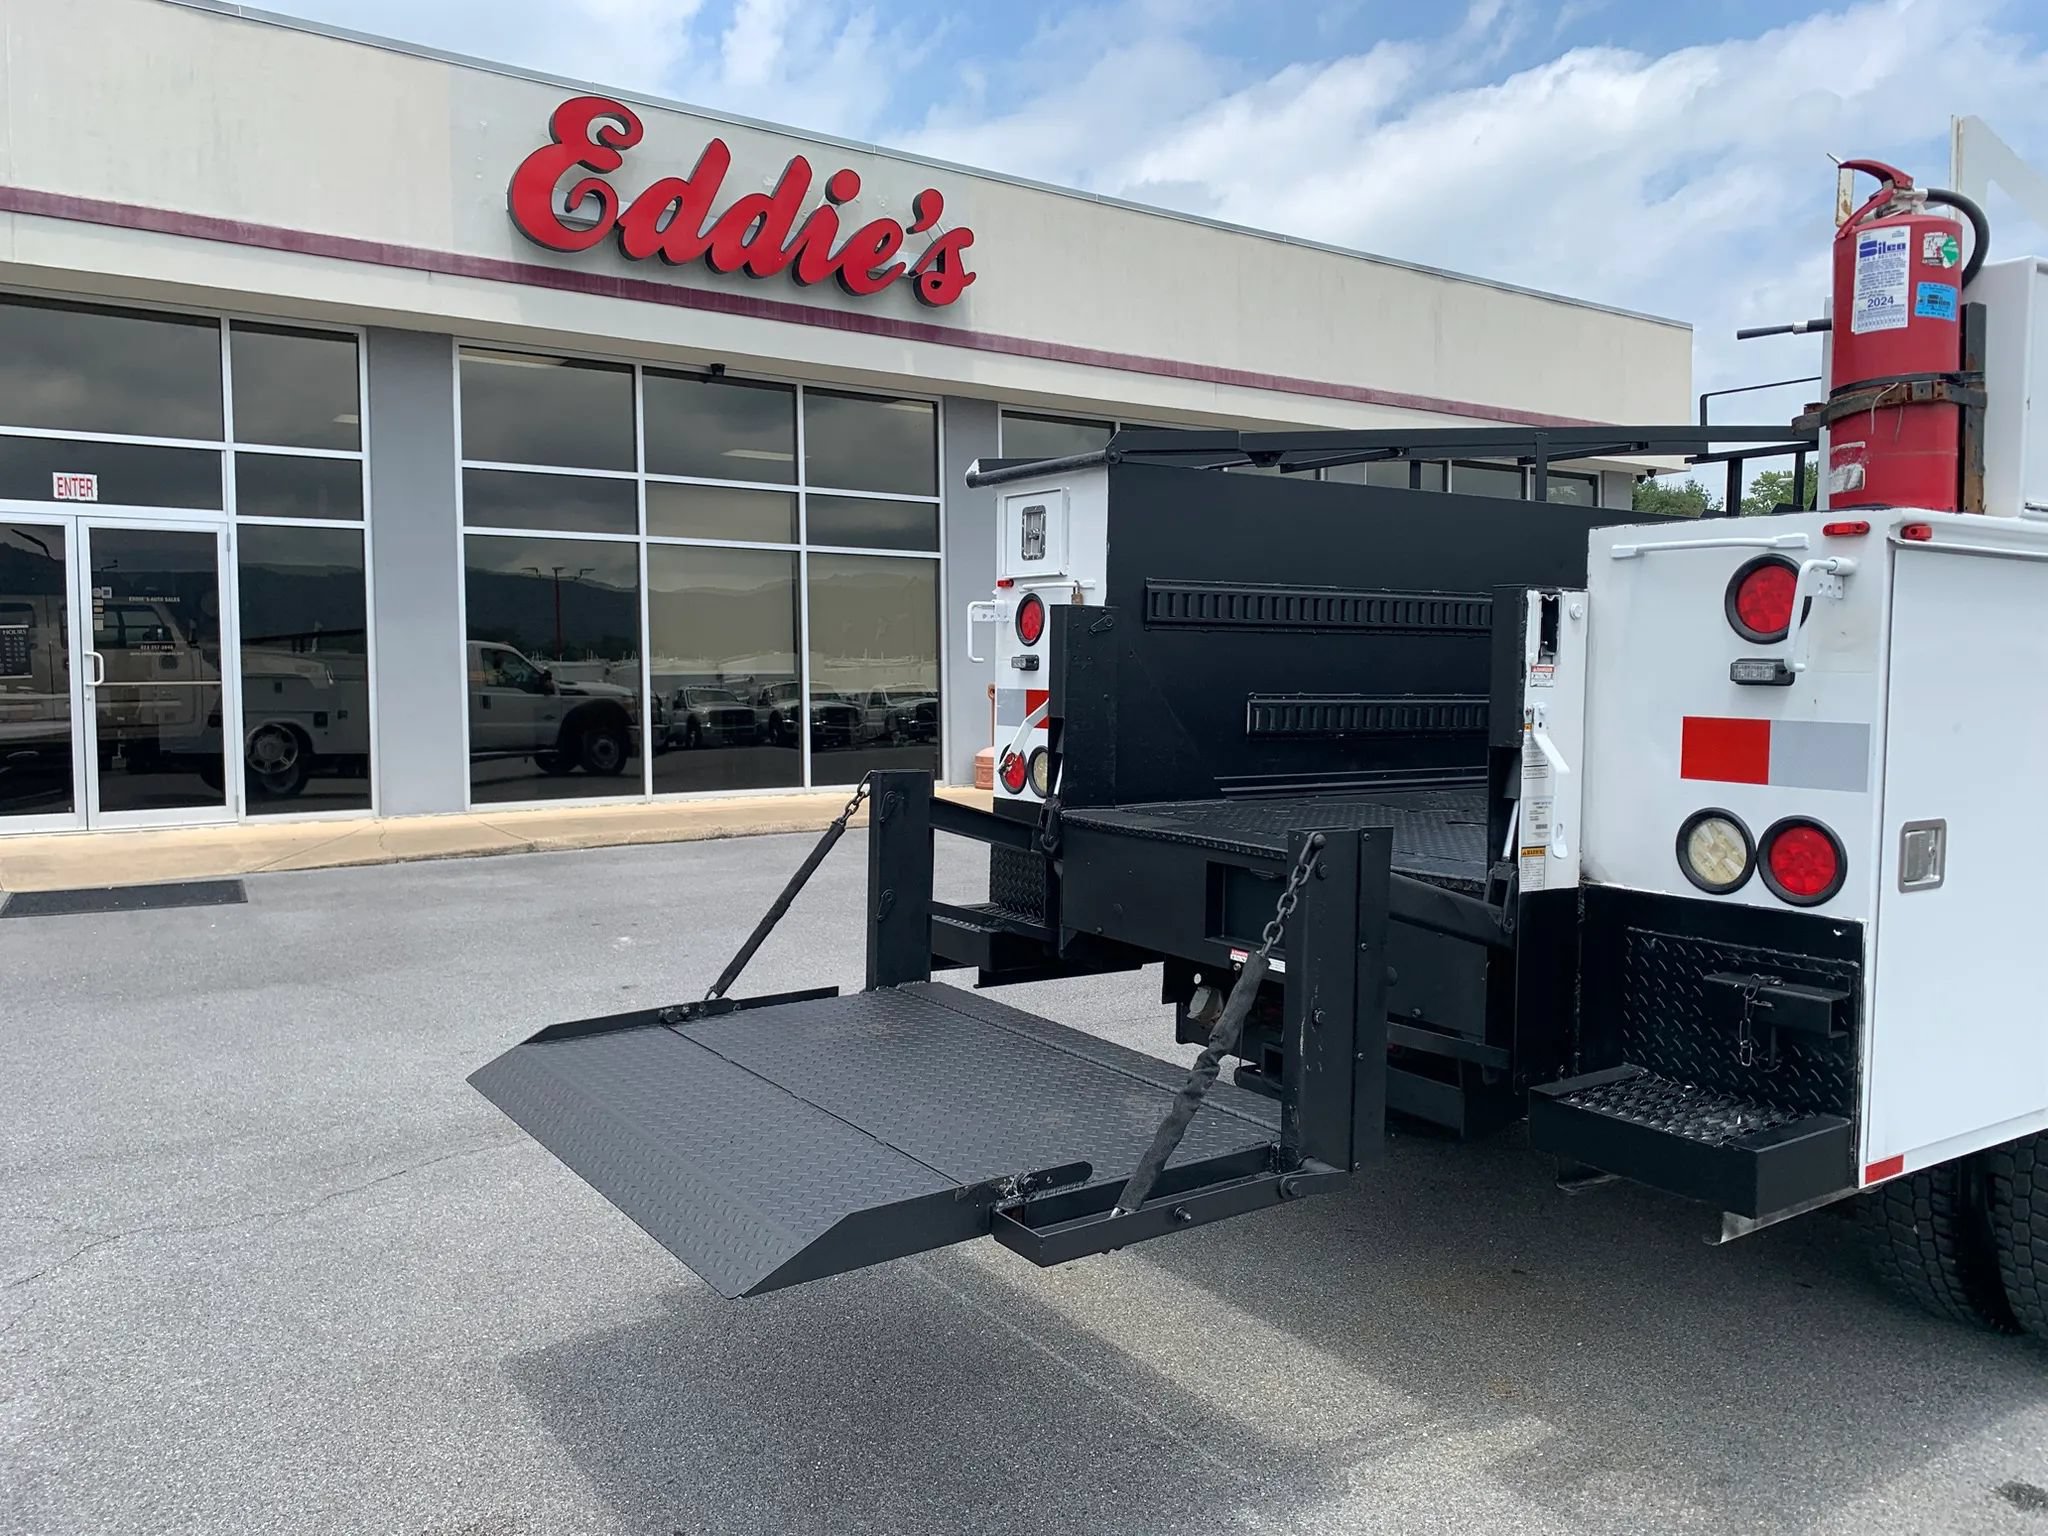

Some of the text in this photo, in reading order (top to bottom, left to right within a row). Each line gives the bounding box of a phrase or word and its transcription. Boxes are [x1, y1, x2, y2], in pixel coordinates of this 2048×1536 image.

[507, 95, 977, 308] Eddie's
[1859, 240, 1906, 258] Silco
[1867, 296, 1895, 308] 2024
[57, 476, 94, 498] ENTER
